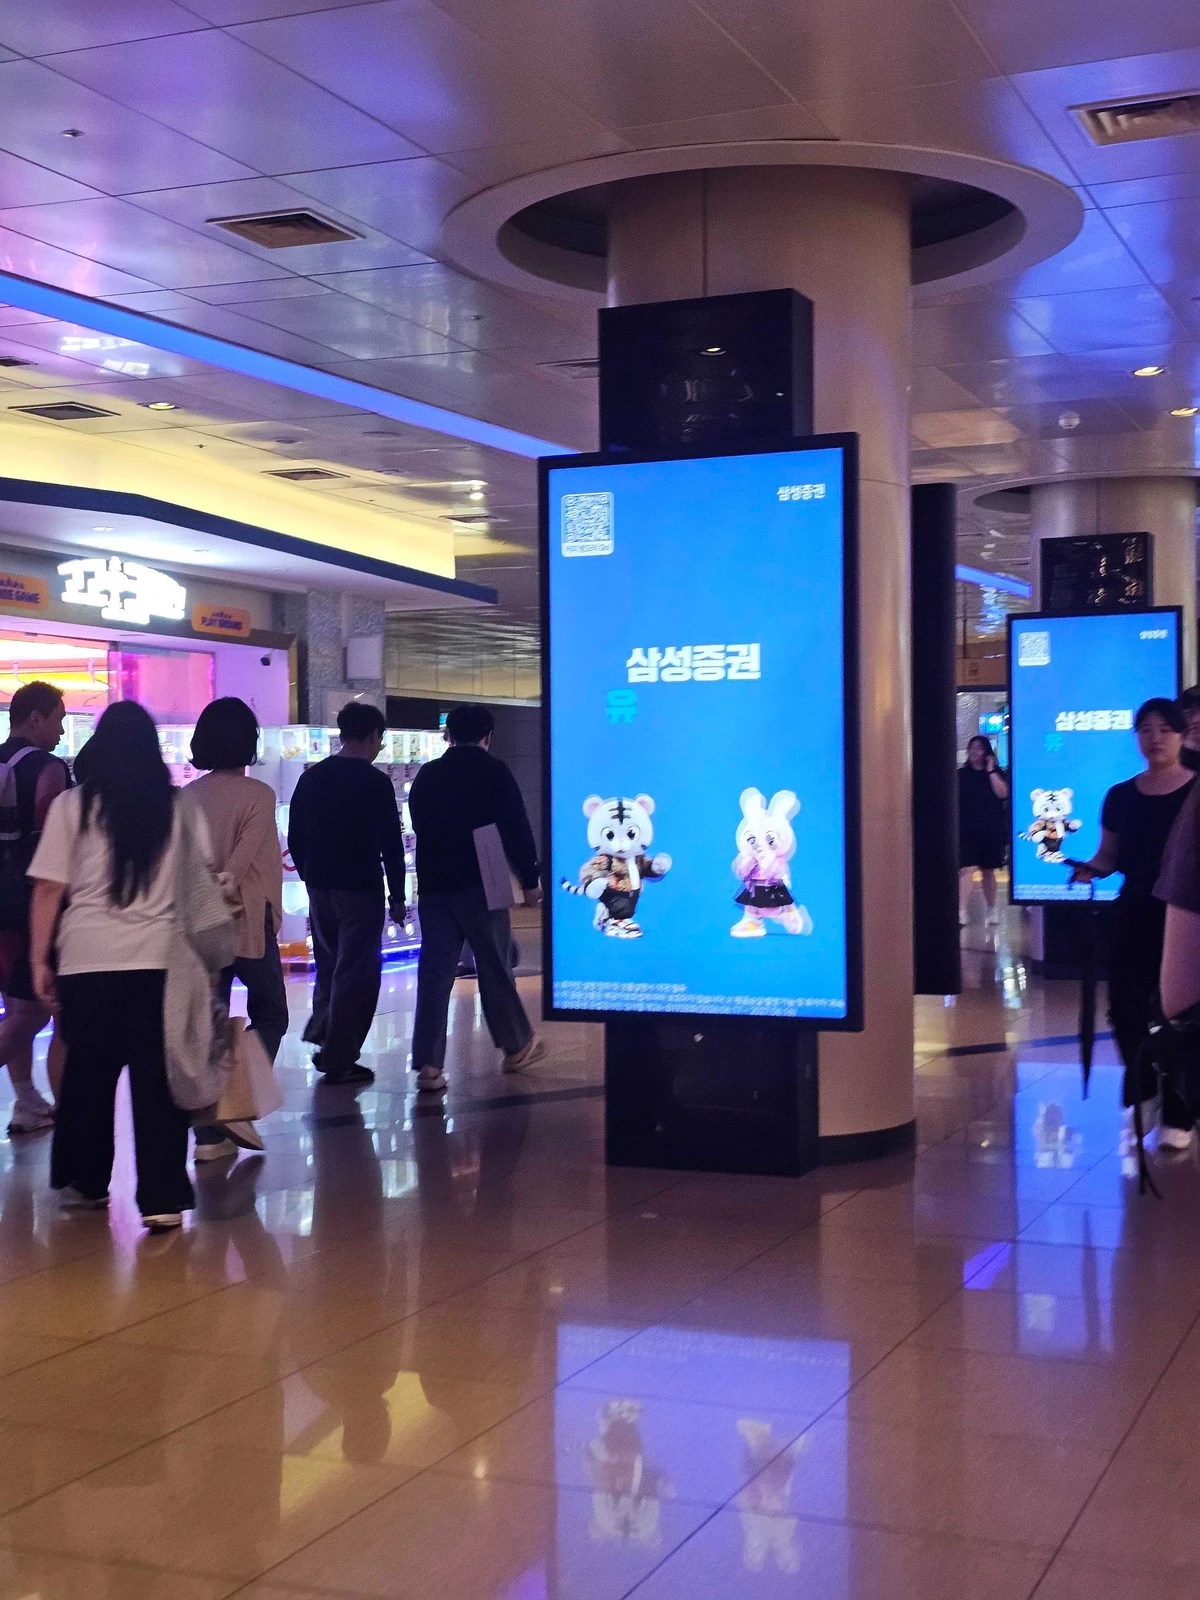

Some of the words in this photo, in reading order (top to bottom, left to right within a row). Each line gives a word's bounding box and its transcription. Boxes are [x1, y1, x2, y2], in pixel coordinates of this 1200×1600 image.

[777, 483, 826, 501] 삼성증권
[626, 643, 762, 683] 삼성증권
[606, 689, 637, 724] 유
[1055, 709, 1134, 731] 삼성증권
